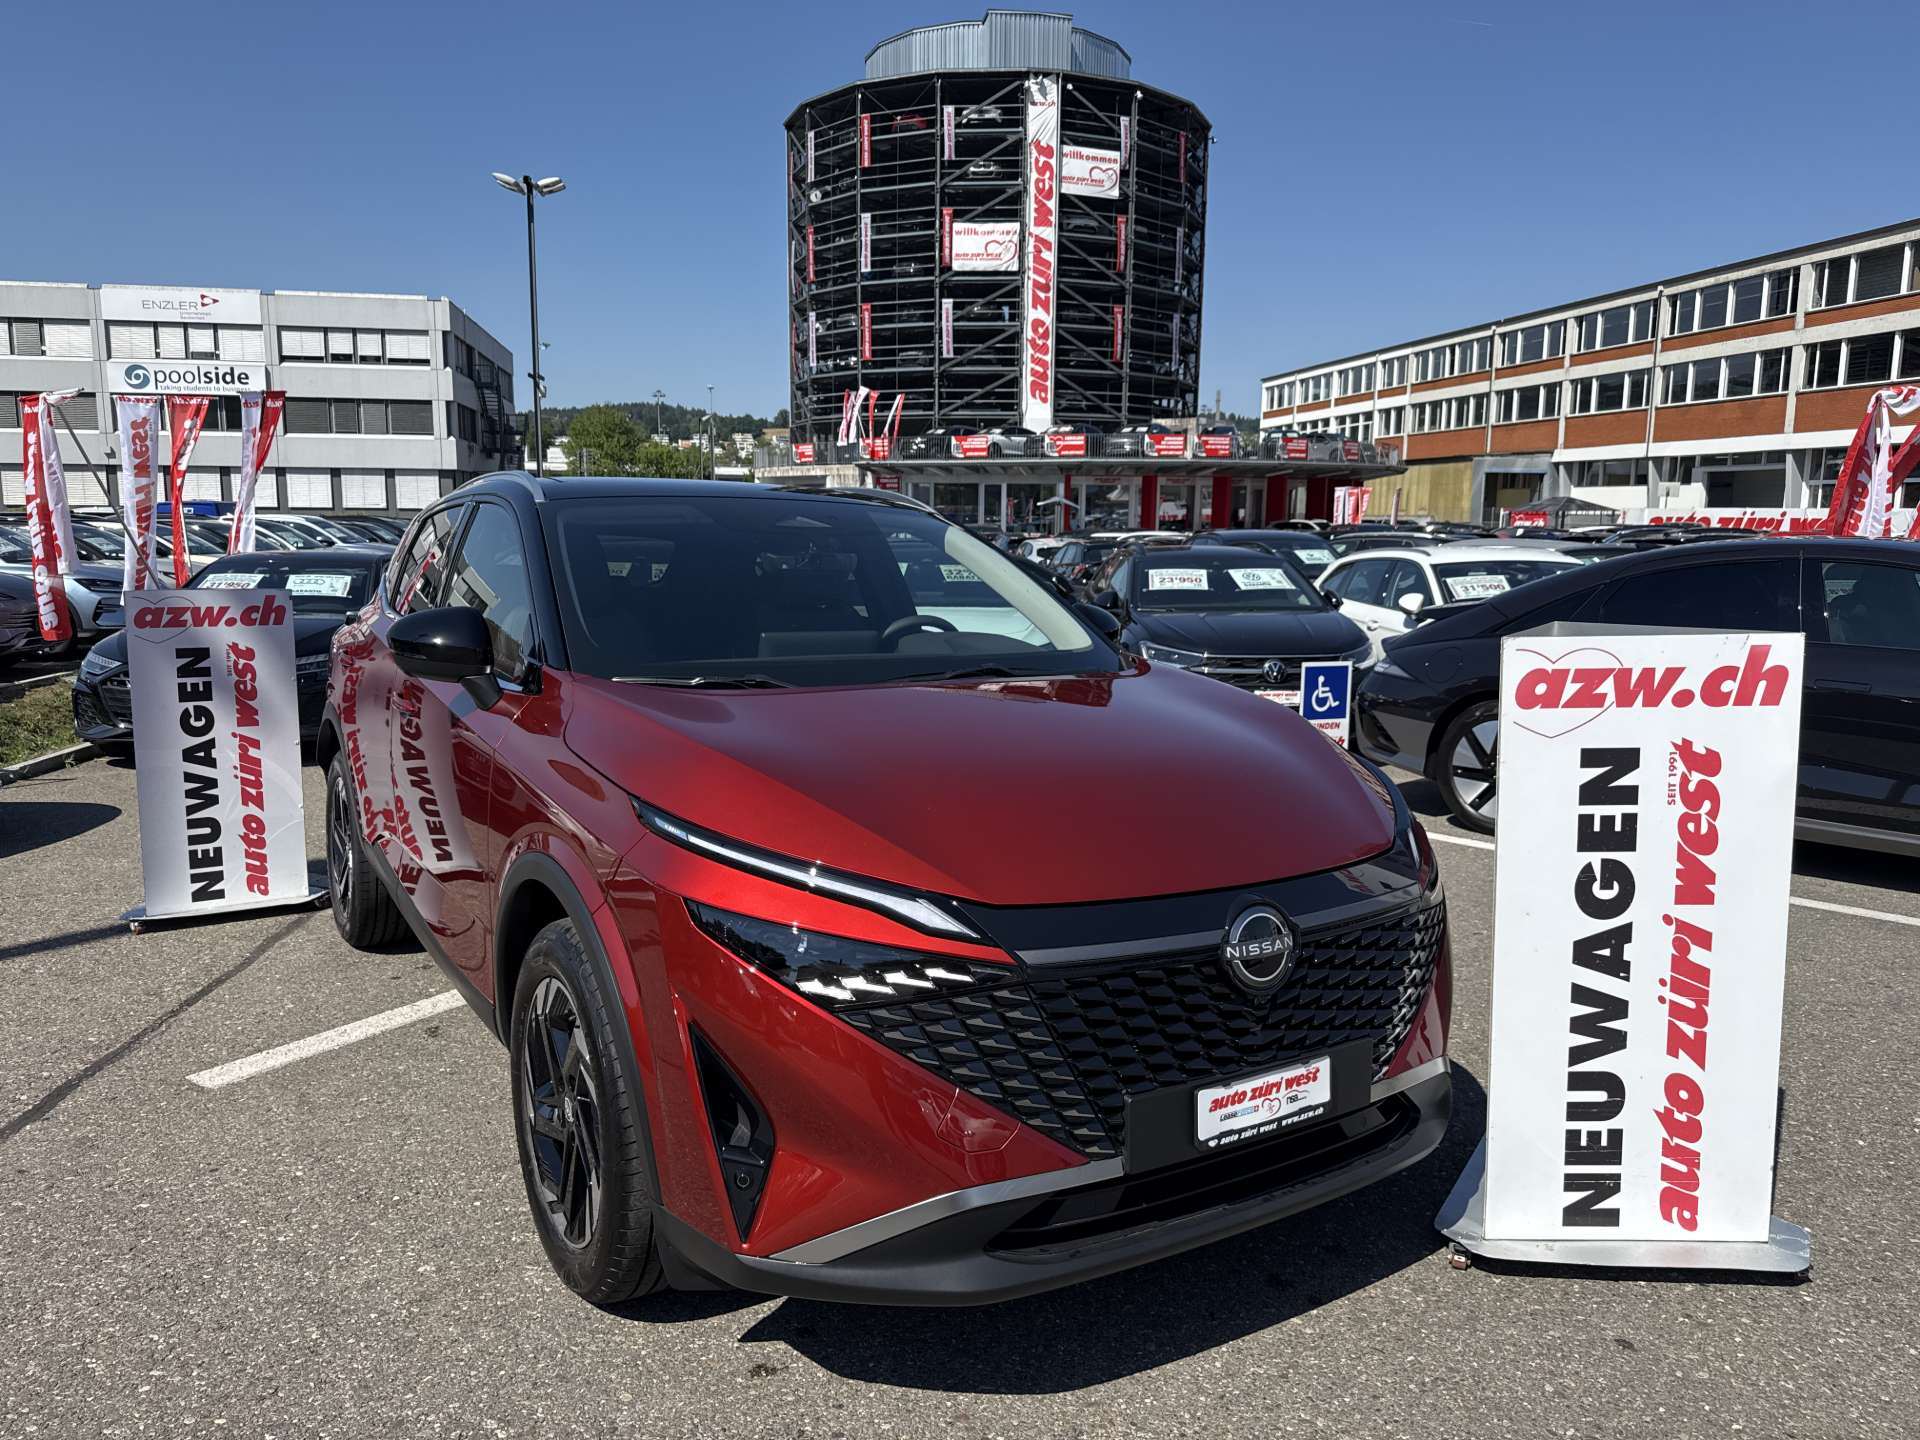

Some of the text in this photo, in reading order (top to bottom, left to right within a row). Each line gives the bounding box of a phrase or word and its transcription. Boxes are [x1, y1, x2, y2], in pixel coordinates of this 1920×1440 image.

[1061, 150, 1119, 164] willkommen
[1031, 138, 1055, 228] west
[142, 299, 199, 311] ENZLER
[154, 365, 250, 390] poolside
[1028, 318, 1051, 405] auto
[160, 384, 182, 392] taking
[133, 594, 287, 629] azw.ch
[1514, 644, 1790, 710] azw.ch
[175, 647, 226, 903] NEUWAGEN
[226, 641, 270, 896] auto züri west
[1667, 751, 1678, 806] SEIT 1991
[1226, 937, 1293, 959] NISSAN
[1562, 747, 1641, 1227] NEUWAGEN
[1653, 736, 1723, 1232] auto züri west
[1208, 1066, 1321, 1113] auto züri west
[1219, 1134, 1239, 1144] auto
[1240, 1127, 1258, 1139] züri
[1260, 1121, 1278, 1133] west
